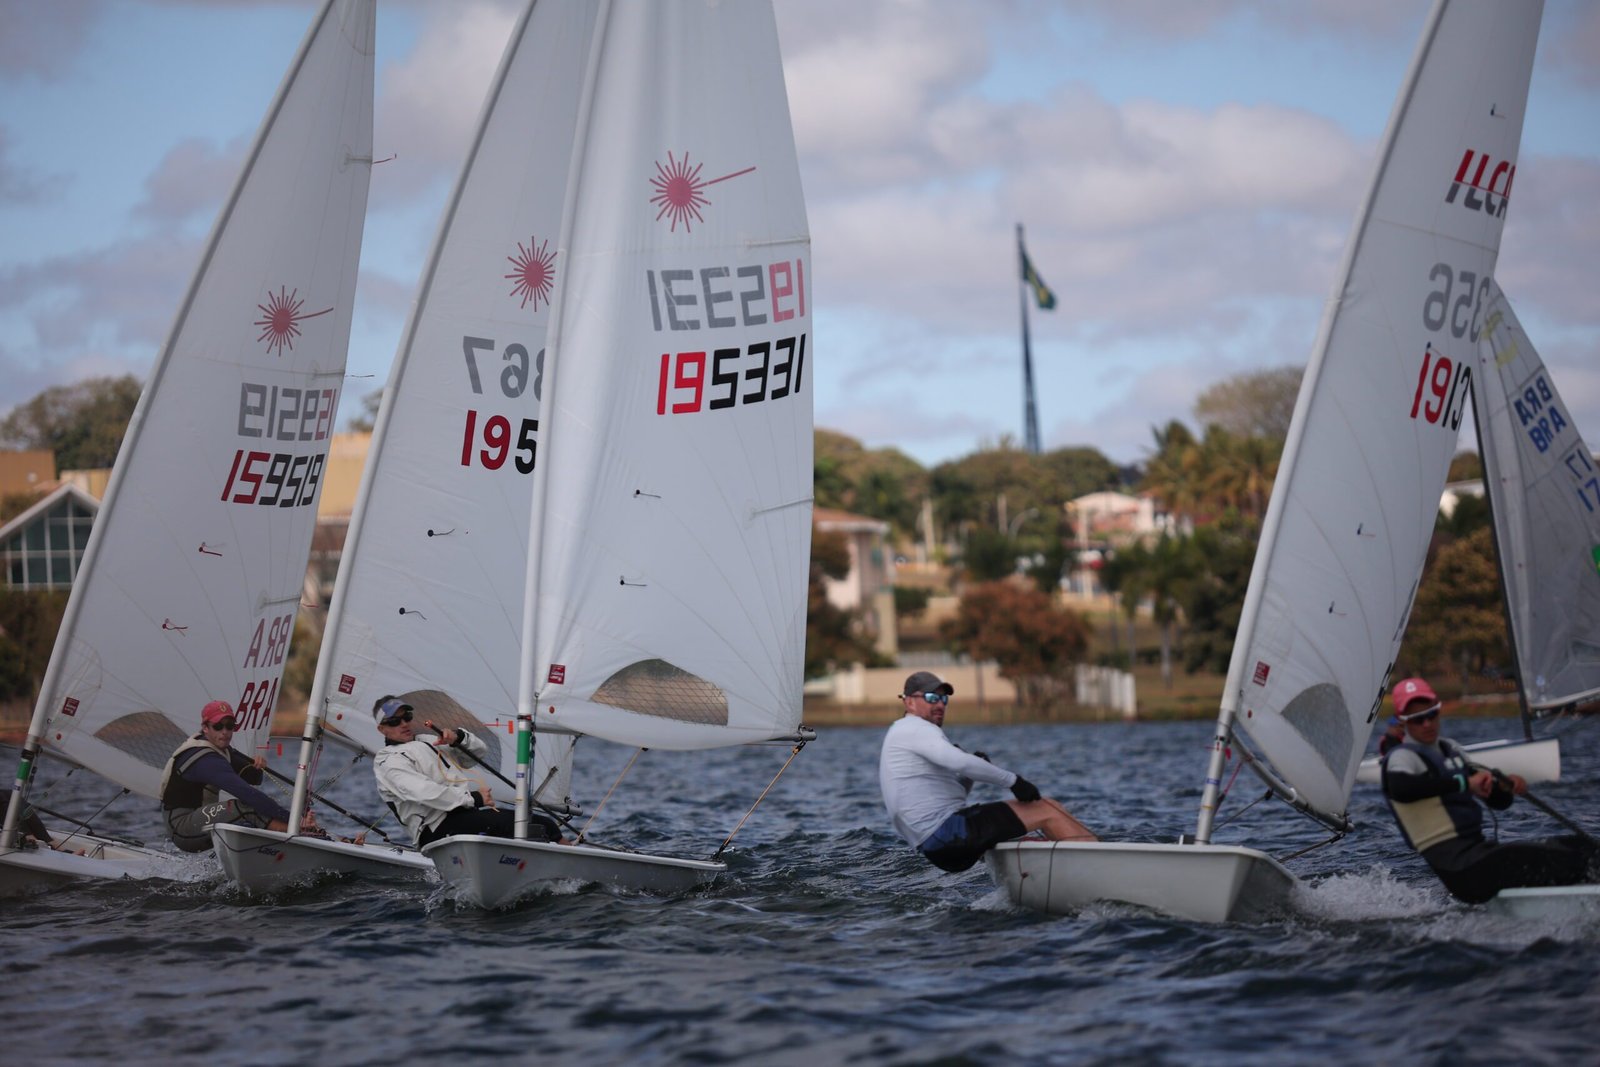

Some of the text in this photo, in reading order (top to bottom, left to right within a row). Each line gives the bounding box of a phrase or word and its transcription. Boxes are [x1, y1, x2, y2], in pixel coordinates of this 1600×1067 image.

[1445, 149, 1516, 220] ILCA
[657, 333, 806, 415] 195331
[1529, 406, 1567, 453] BRA
[220, 449, 325, 507] 159519
[234, 677, 279, 732] BRA
